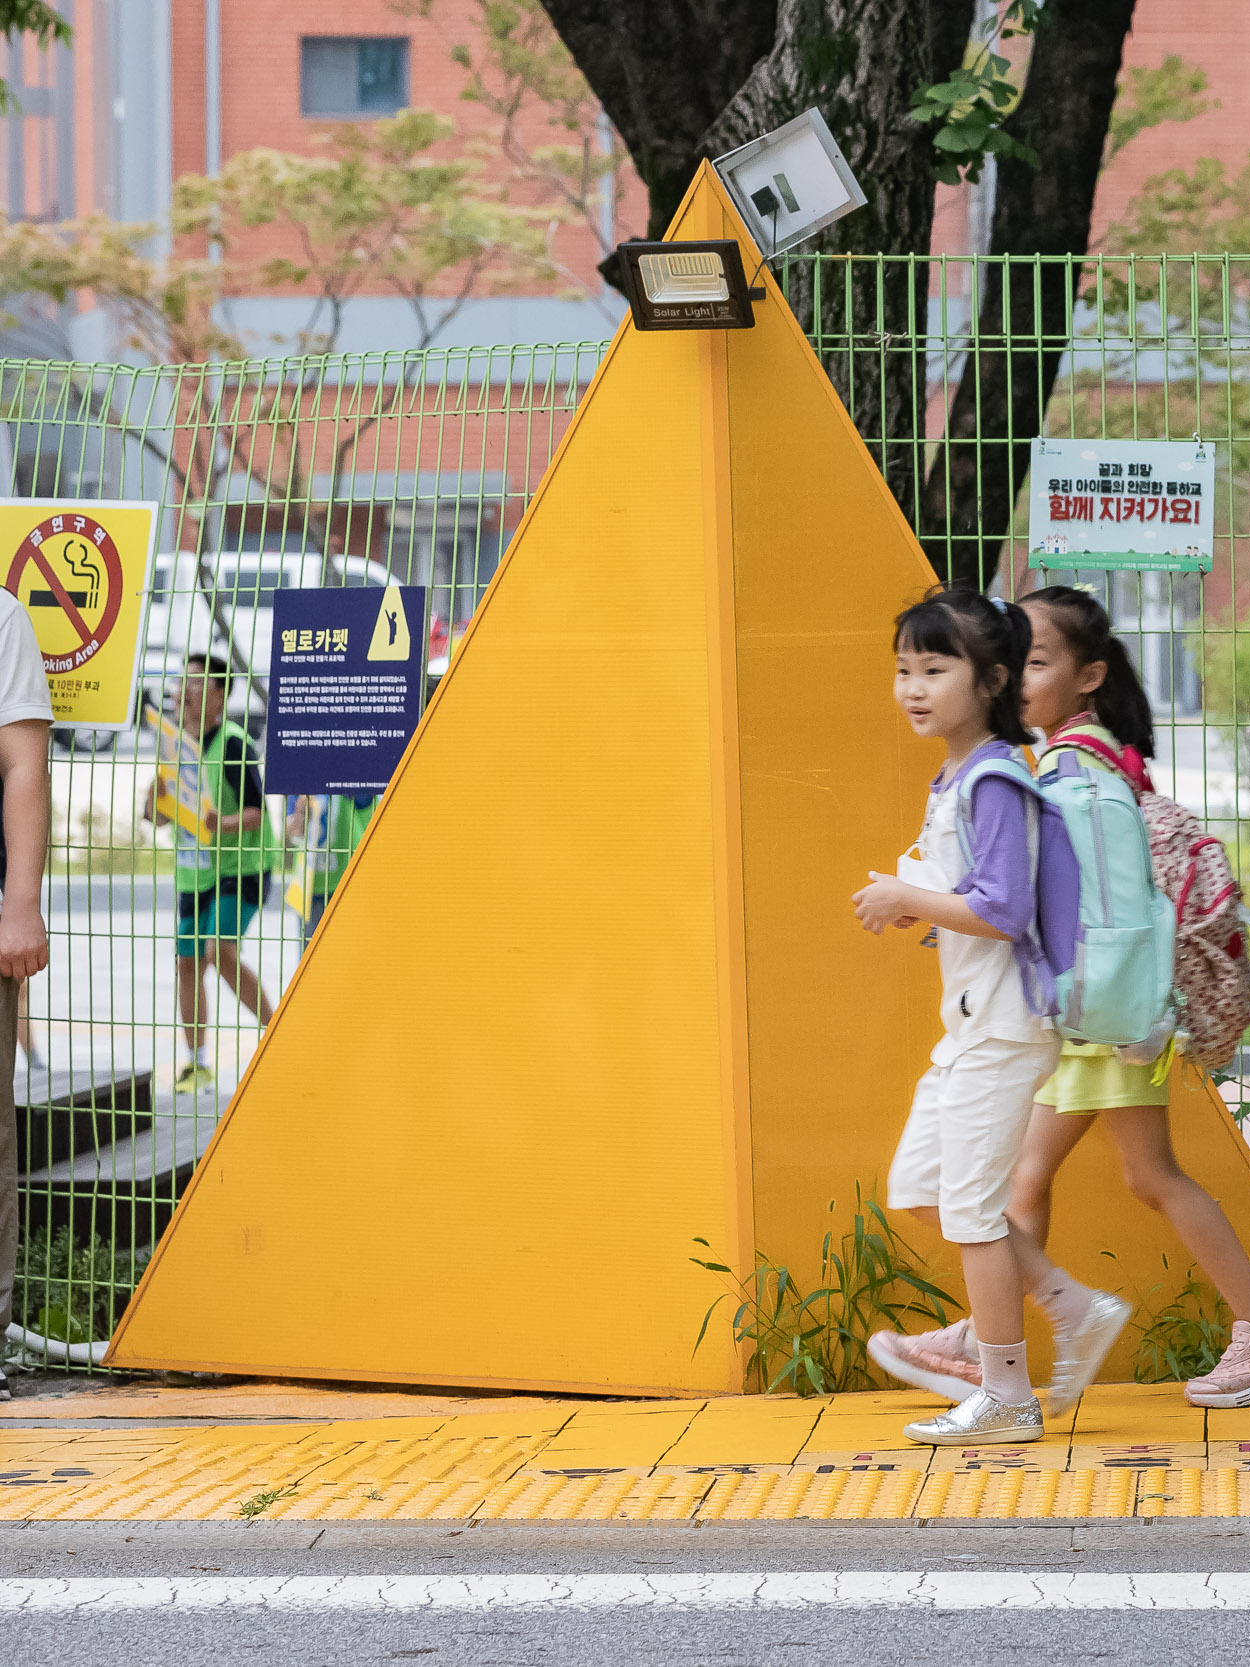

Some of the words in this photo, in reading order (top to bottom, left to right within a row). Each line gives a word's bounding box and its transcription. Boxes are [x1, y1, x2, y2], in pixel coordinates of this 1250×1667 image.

[653, 308, 680, 317] Solar
[684, 307, 711, 318] Light
[1127, 463, 1152, 477] 희망
[1048, 478, 1073, 494] 우리
[1076, 479, 1125, 495] 아이들의
[1127, 480, 1163, 496] 안전한
[1049, 494, 1094, 523] 함께
[1099, 496, 1200, 525] 지켜가요!
[29, 515, 107, 547] 금연구역
[281, 628, 349, 653] 옐로카펫
[43, 657, 73, 672] oking
[75, 639, 100, 666] Area
[57, 680, 83, 692] 10만원
